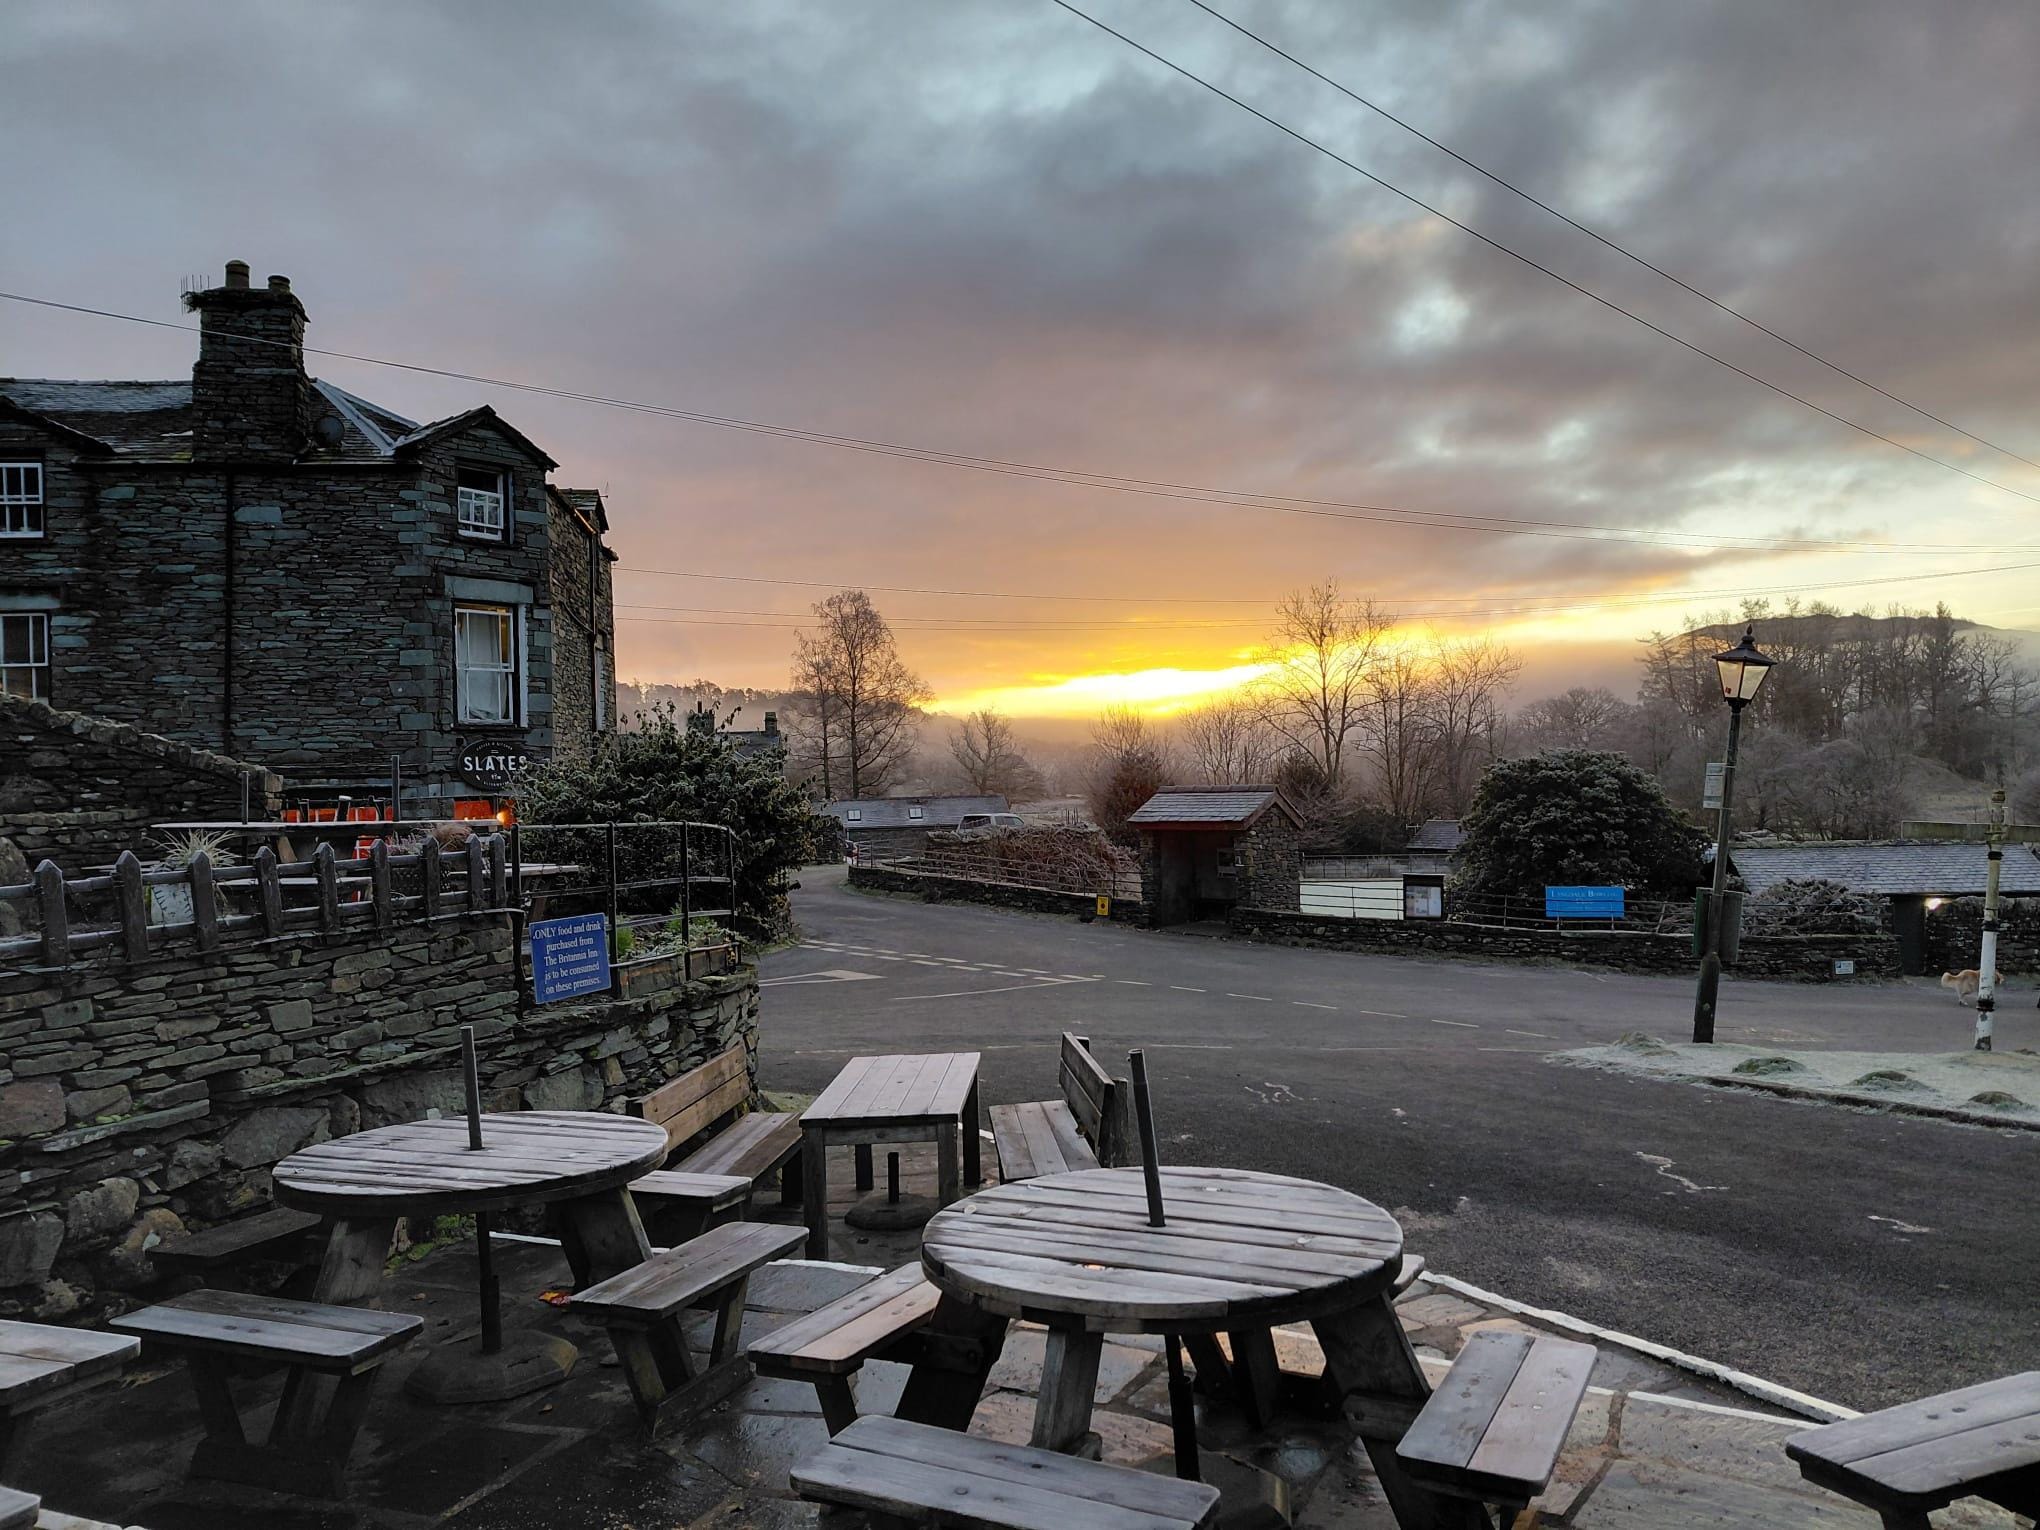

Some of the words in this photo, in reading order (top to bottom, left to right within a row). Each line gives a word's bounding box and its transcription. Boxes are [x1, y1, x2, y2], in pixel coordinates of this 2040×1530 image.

[464, 756, 528, 771] SLATES
[534, 927, 557, 940] ONLY
[558, 925, 572, 936] food
[573, 923, 585, 933] and
[585, 921, 602, 932] drink
[546, 938, 578, 955] purchased
[579, 937, 594, 946] from
[544, 955, 557, 967] The
[558, 952, 587, 964] Britannia
[588, 948, 598, 958] Inn
[552, 970, 559, 979] to
[560, 968, 568, 977] be
[569, 961, 599, 975] consumed
[555, 981, 572, 993] these
